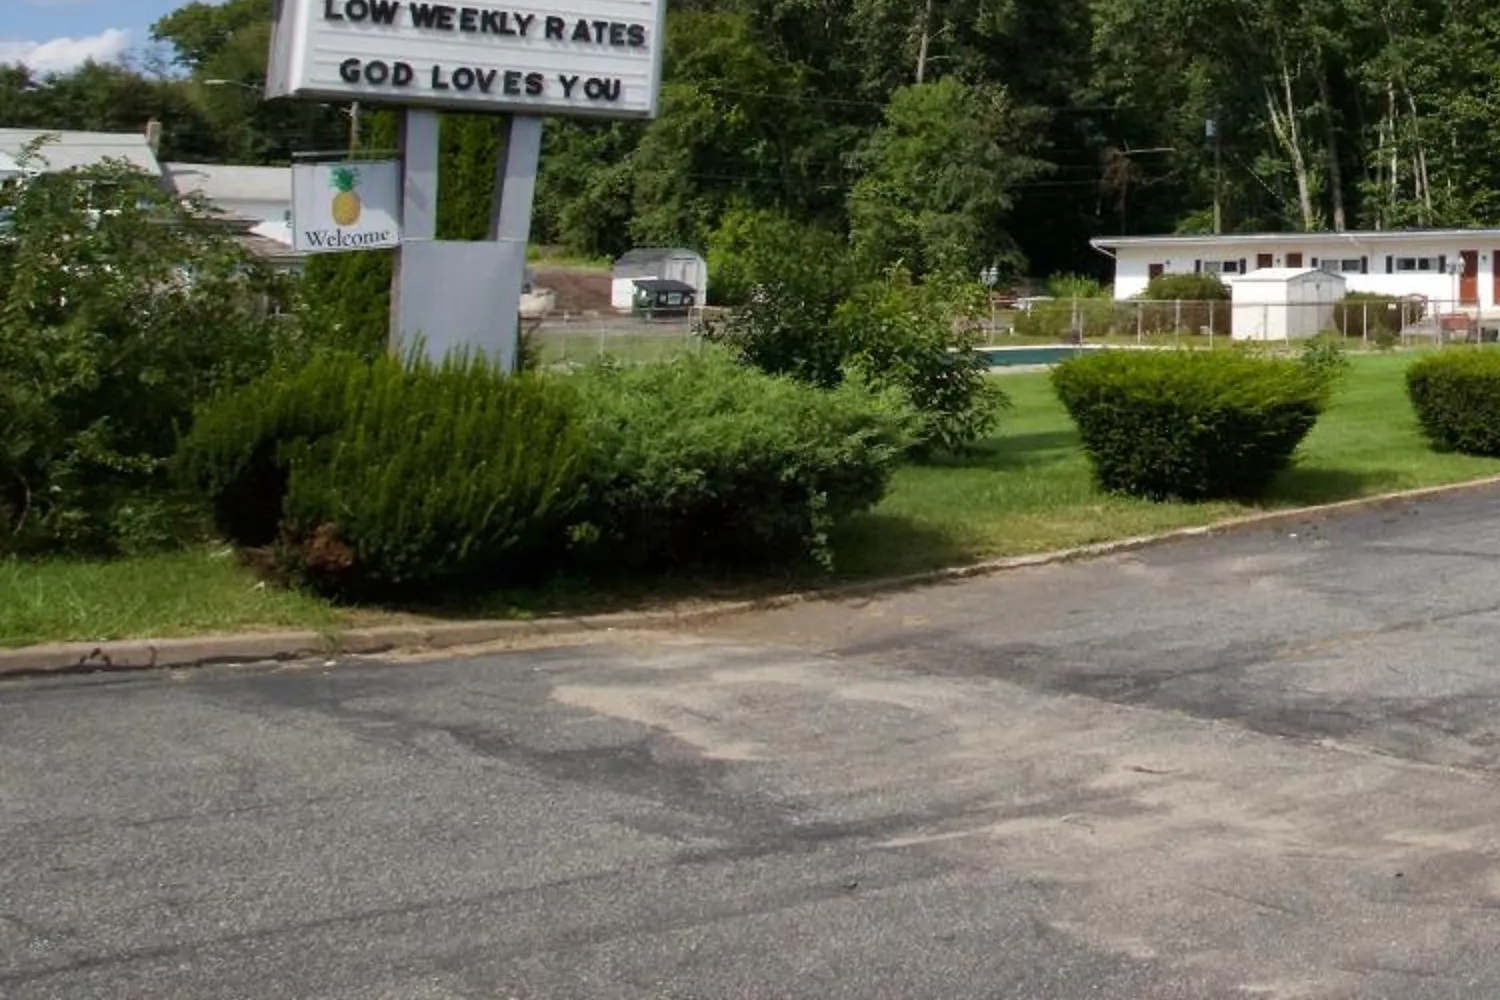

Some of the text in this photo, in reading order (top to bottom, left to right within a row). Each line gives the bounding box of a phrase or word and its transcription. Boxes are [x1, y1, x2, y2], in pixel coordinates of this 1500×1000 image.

[408, 1, 535, 37] WEEKLY
[545, 17, 646, 47] RATES
[339, 57, 622, 102] GOD LOVES YOU
[304, 227, 391, 248] Welcome
